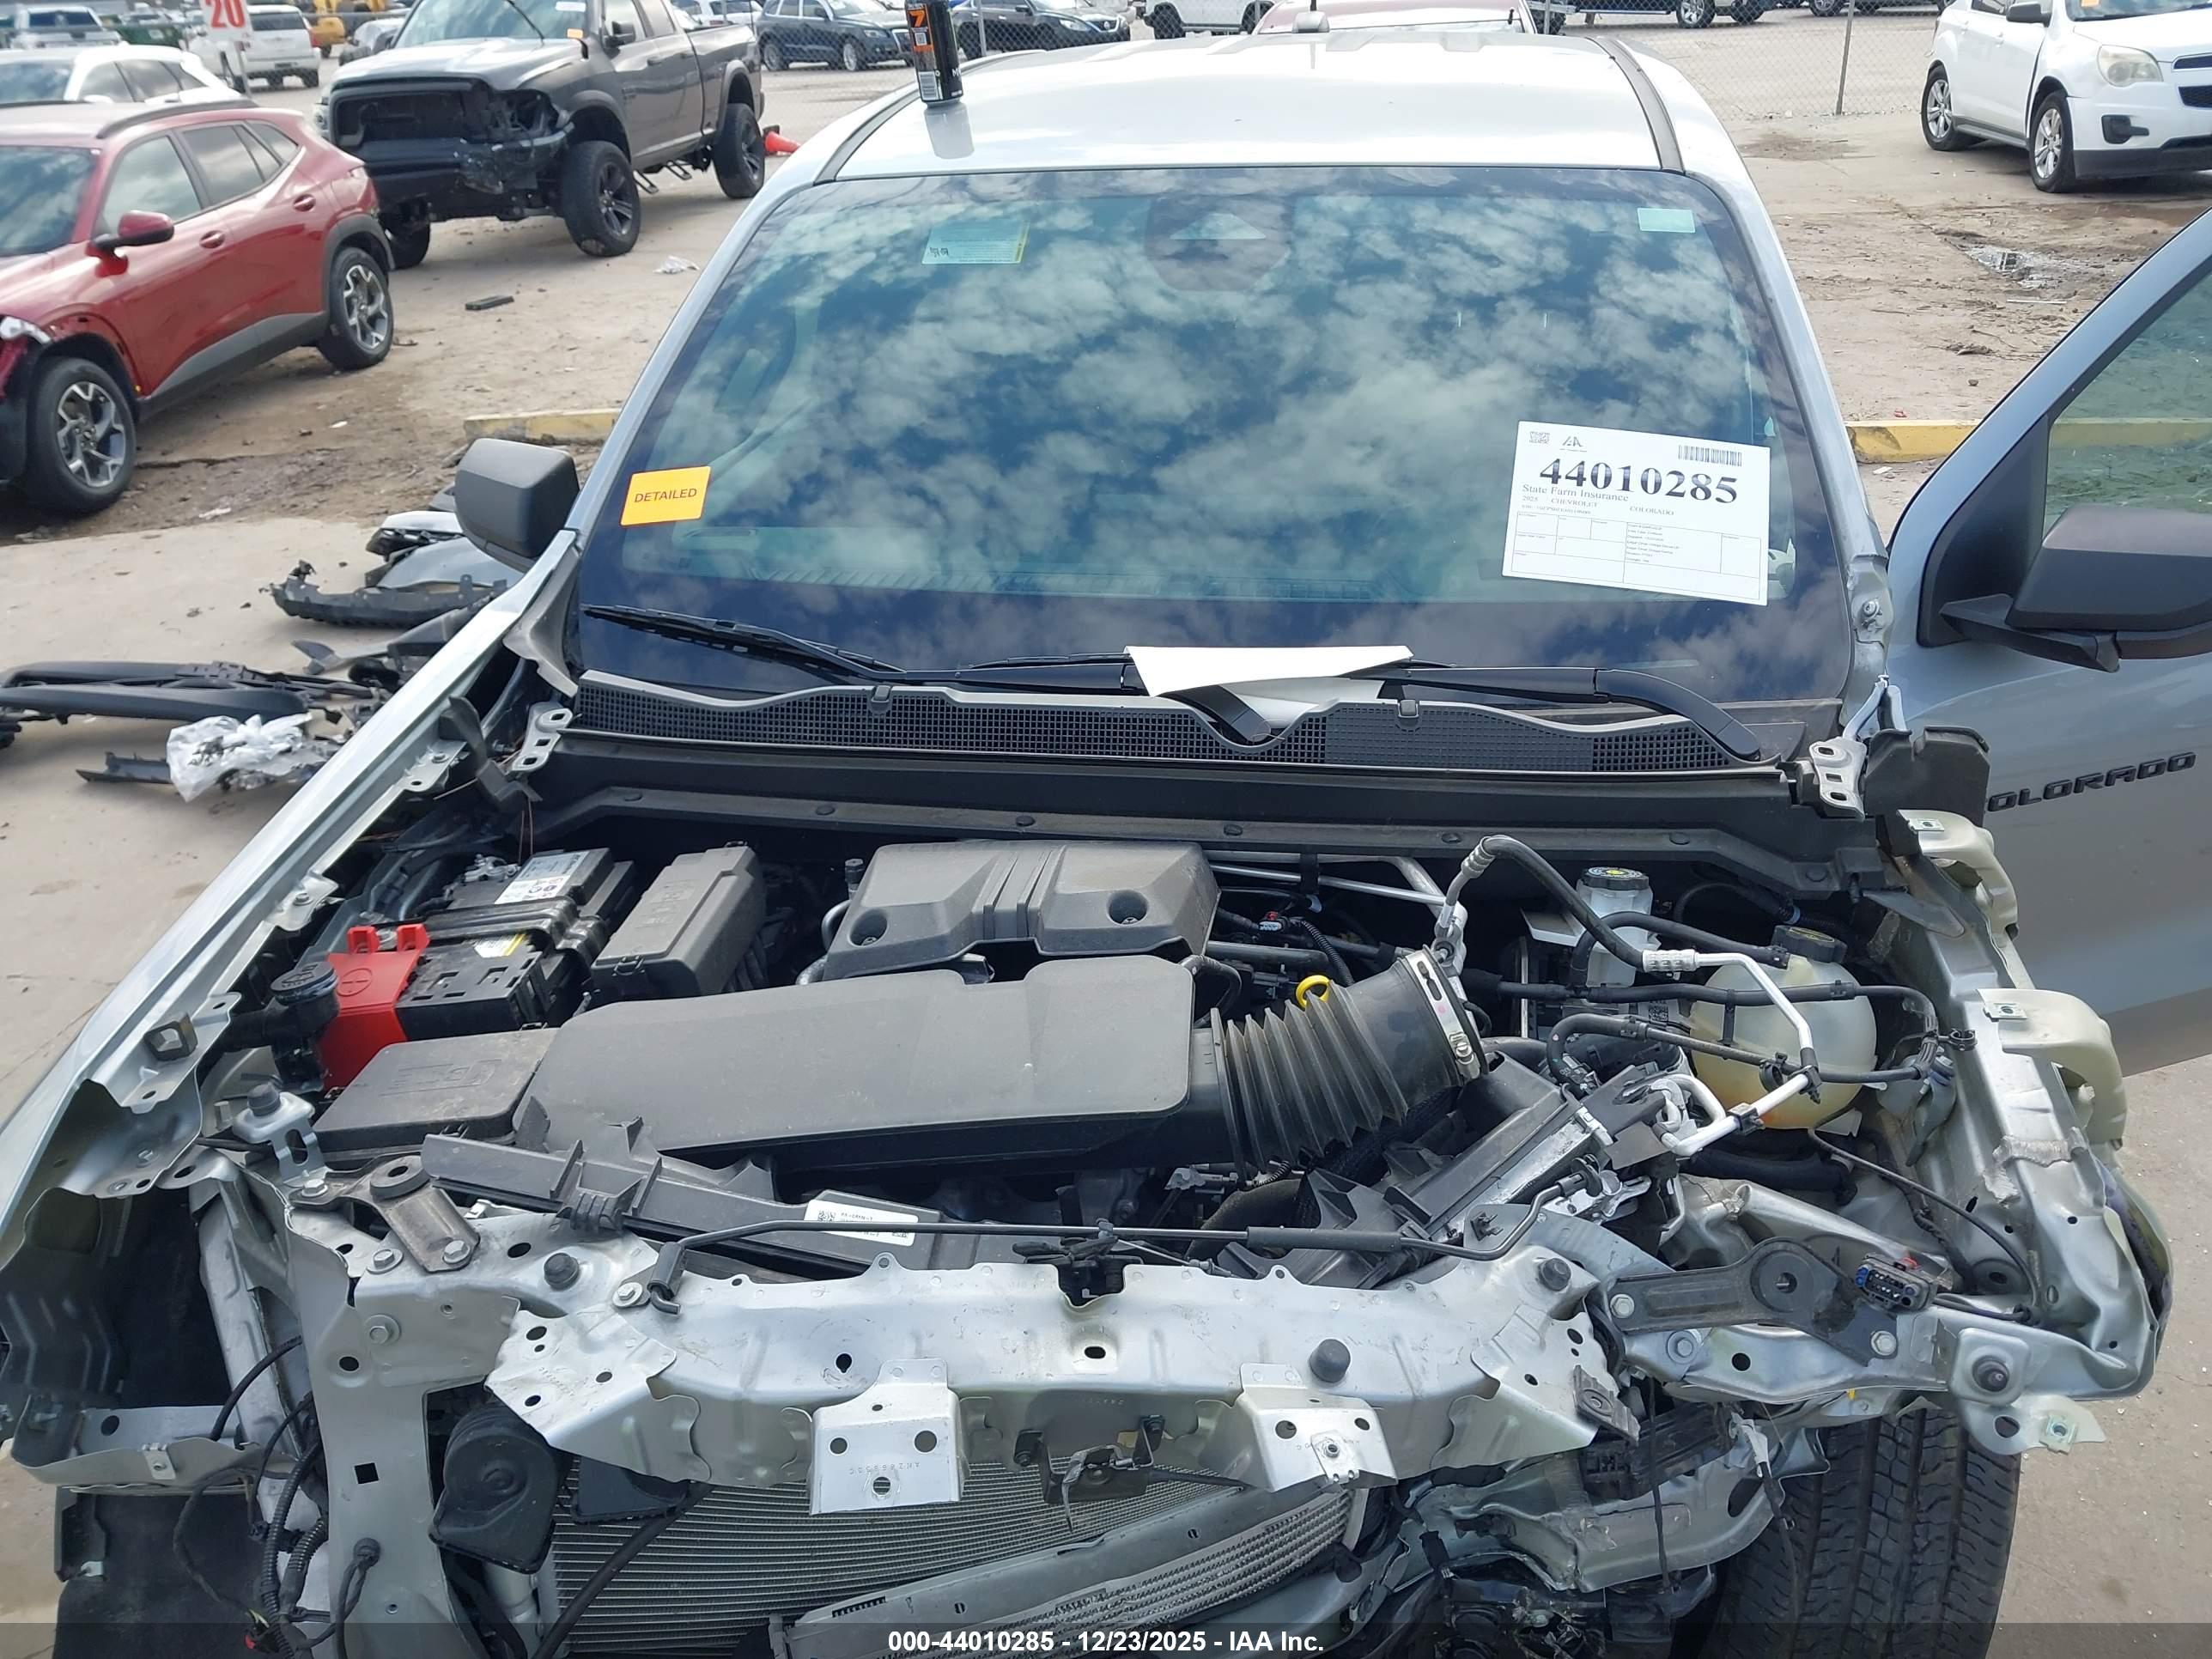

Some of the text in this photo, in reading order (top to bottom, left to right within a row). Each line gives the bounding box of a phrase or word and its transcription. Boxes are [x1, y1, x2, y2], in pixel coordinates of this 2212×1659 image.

[205, 0, 246, 28] 20
[1522, 483, 1629, 502] State Farm Insurance
[1540, 458, 1738, 504] 44010285
[635, 488, 697, 503] DETAILED
[1551, 497, 1599, 508] CHEVROLET
[1629, 505, 1675, 516] COLORADO
[1984, 750, 2197, 812] OLORADO
